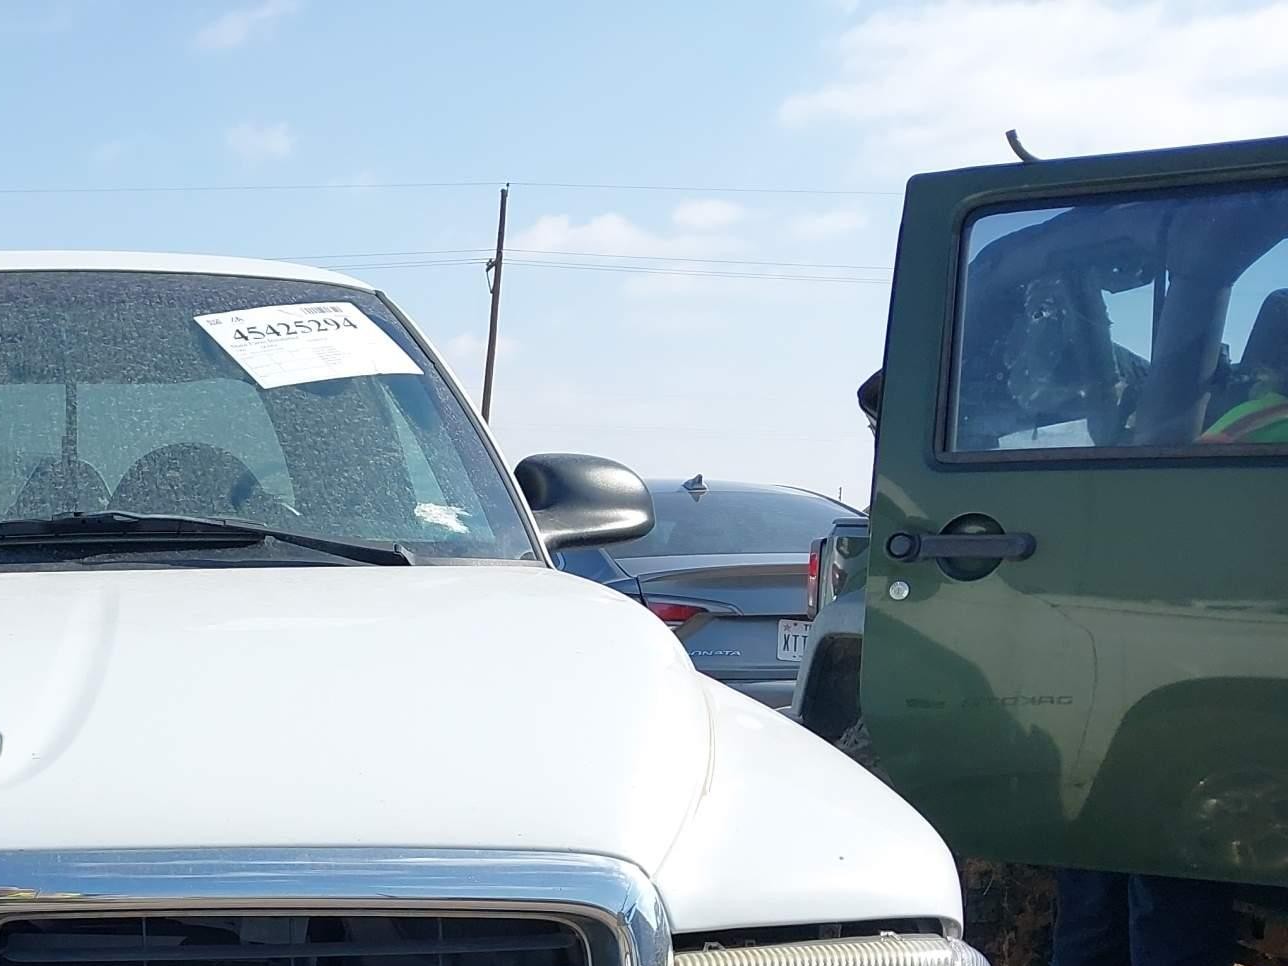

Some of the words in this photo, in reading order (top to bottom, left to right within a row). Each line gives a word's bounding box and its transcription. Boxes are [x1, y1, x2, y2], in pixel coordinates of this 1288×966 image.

[232, 316, 359, 342] 45425294
[782, 633, 810, 652] XTT
[690, 649, 742, 657] ONATA
